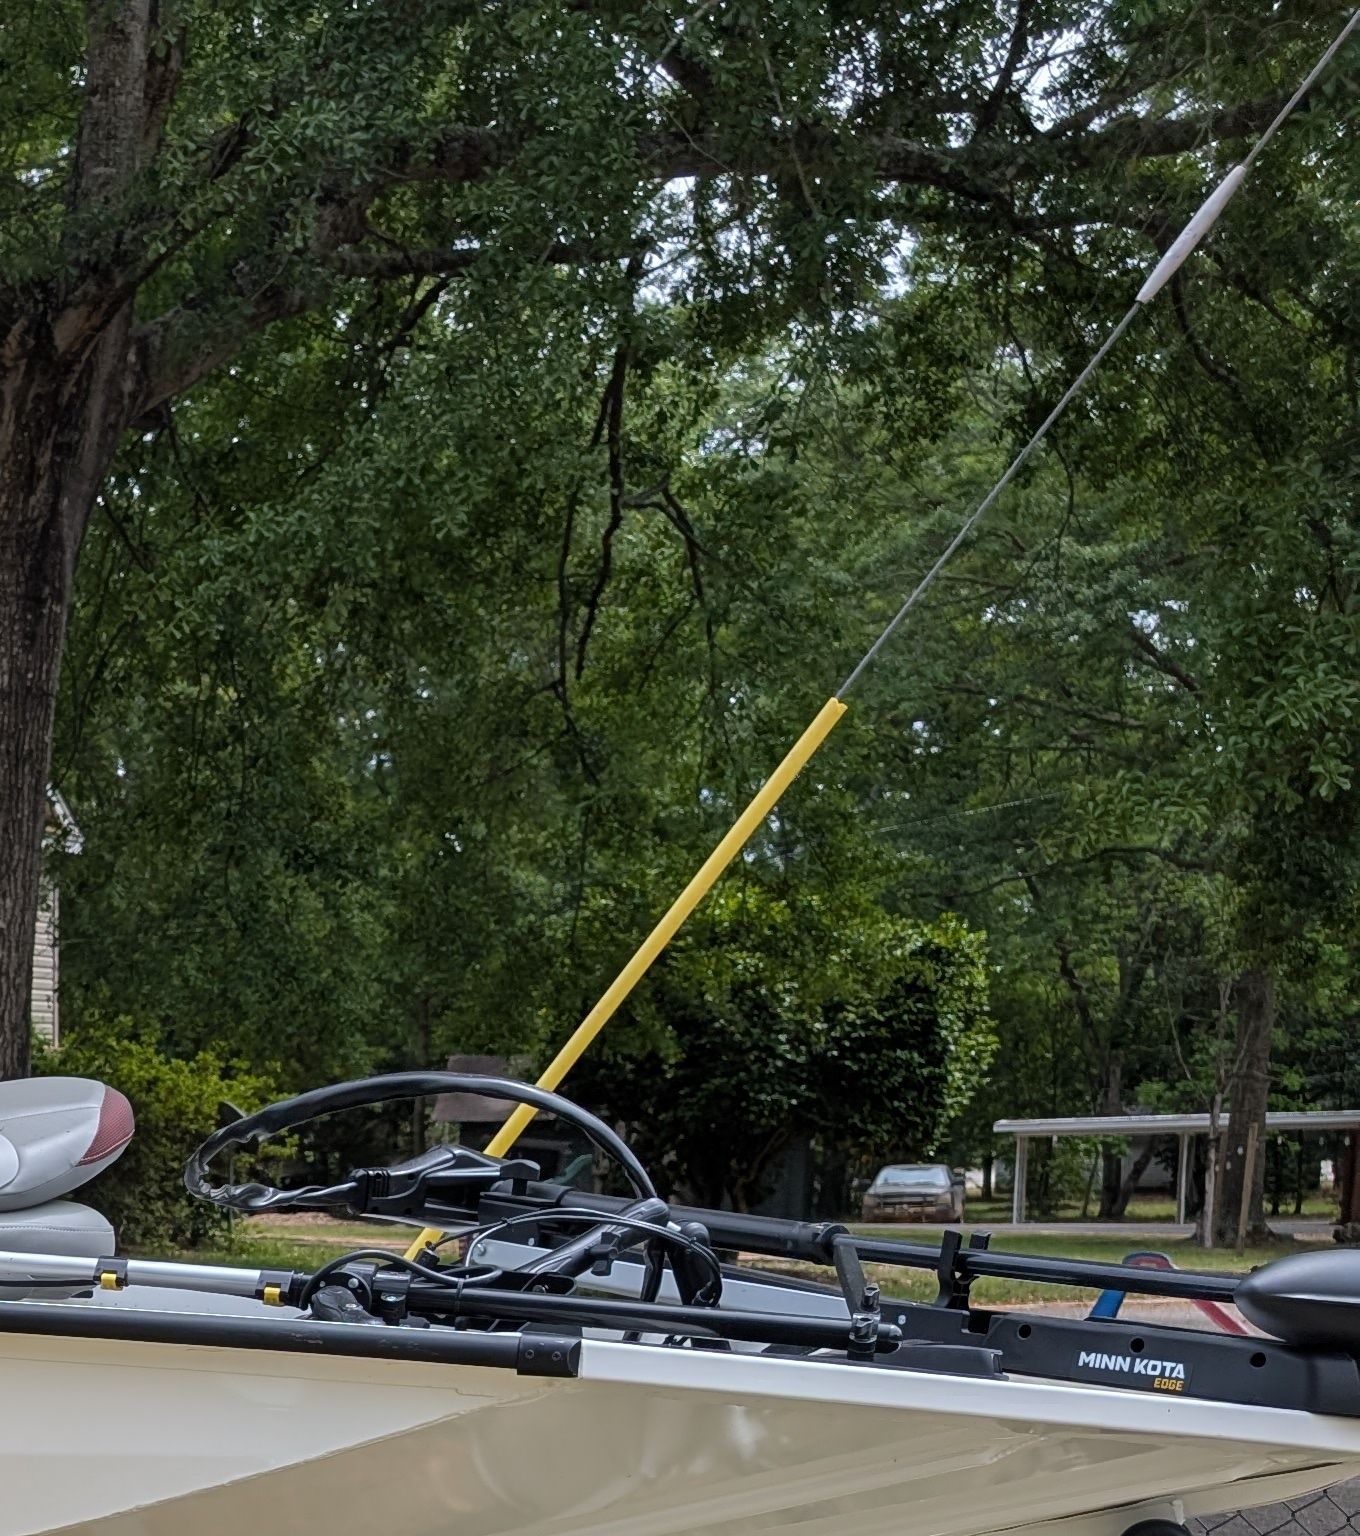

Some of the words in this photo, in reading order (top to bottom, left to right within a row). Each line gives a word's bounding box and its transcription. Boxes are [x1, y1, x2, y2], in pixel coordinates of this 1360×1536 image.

[1078, 1351, 1131, 1372] MINN
[1133, 1358, 1185, 1378] KOTA
[1154, 1378, 1184, 1391] EDGE
